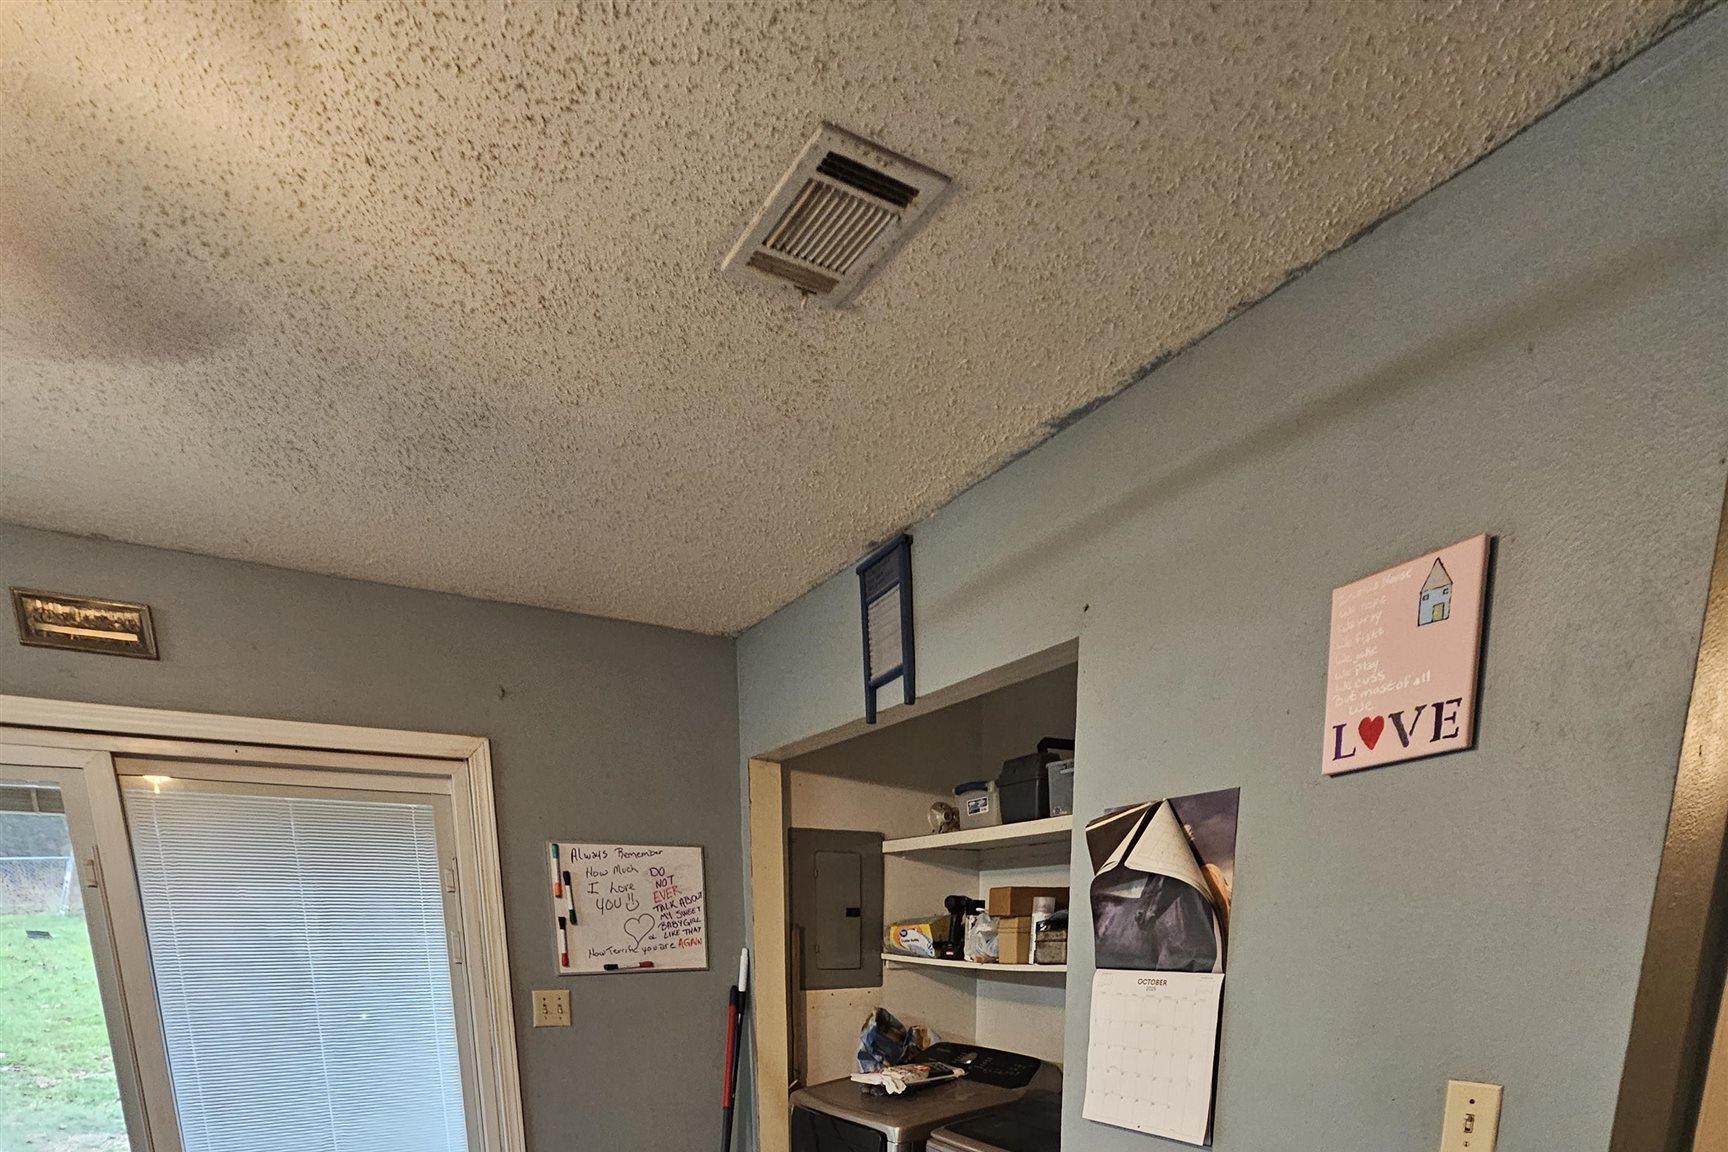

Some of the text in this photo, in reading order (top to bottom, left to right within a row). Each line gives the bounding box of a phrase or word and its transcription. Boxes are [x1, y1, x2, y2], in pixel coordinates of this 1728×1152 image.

[570, 847, 663, 863] Always Remember
[585, 864, 639, 878] How Much
[649, 867, 665, 877] DO
[655, 875, 674, 888] NOT
[587, 882, 599, 895] I
[652, 885, 682, 904] EVER
[653, 891, 703, 913] TALK ABOUT
[660, 907, 702, 921] MY SWEET
[663, 928, 680, 939] LIKE
[682, 926, 702, 937] THAT
[641, 943, 660, 955] you
[677, 937, 703, 950] AGAIN
[1137, 978, 1168, 986] OCTOBER
